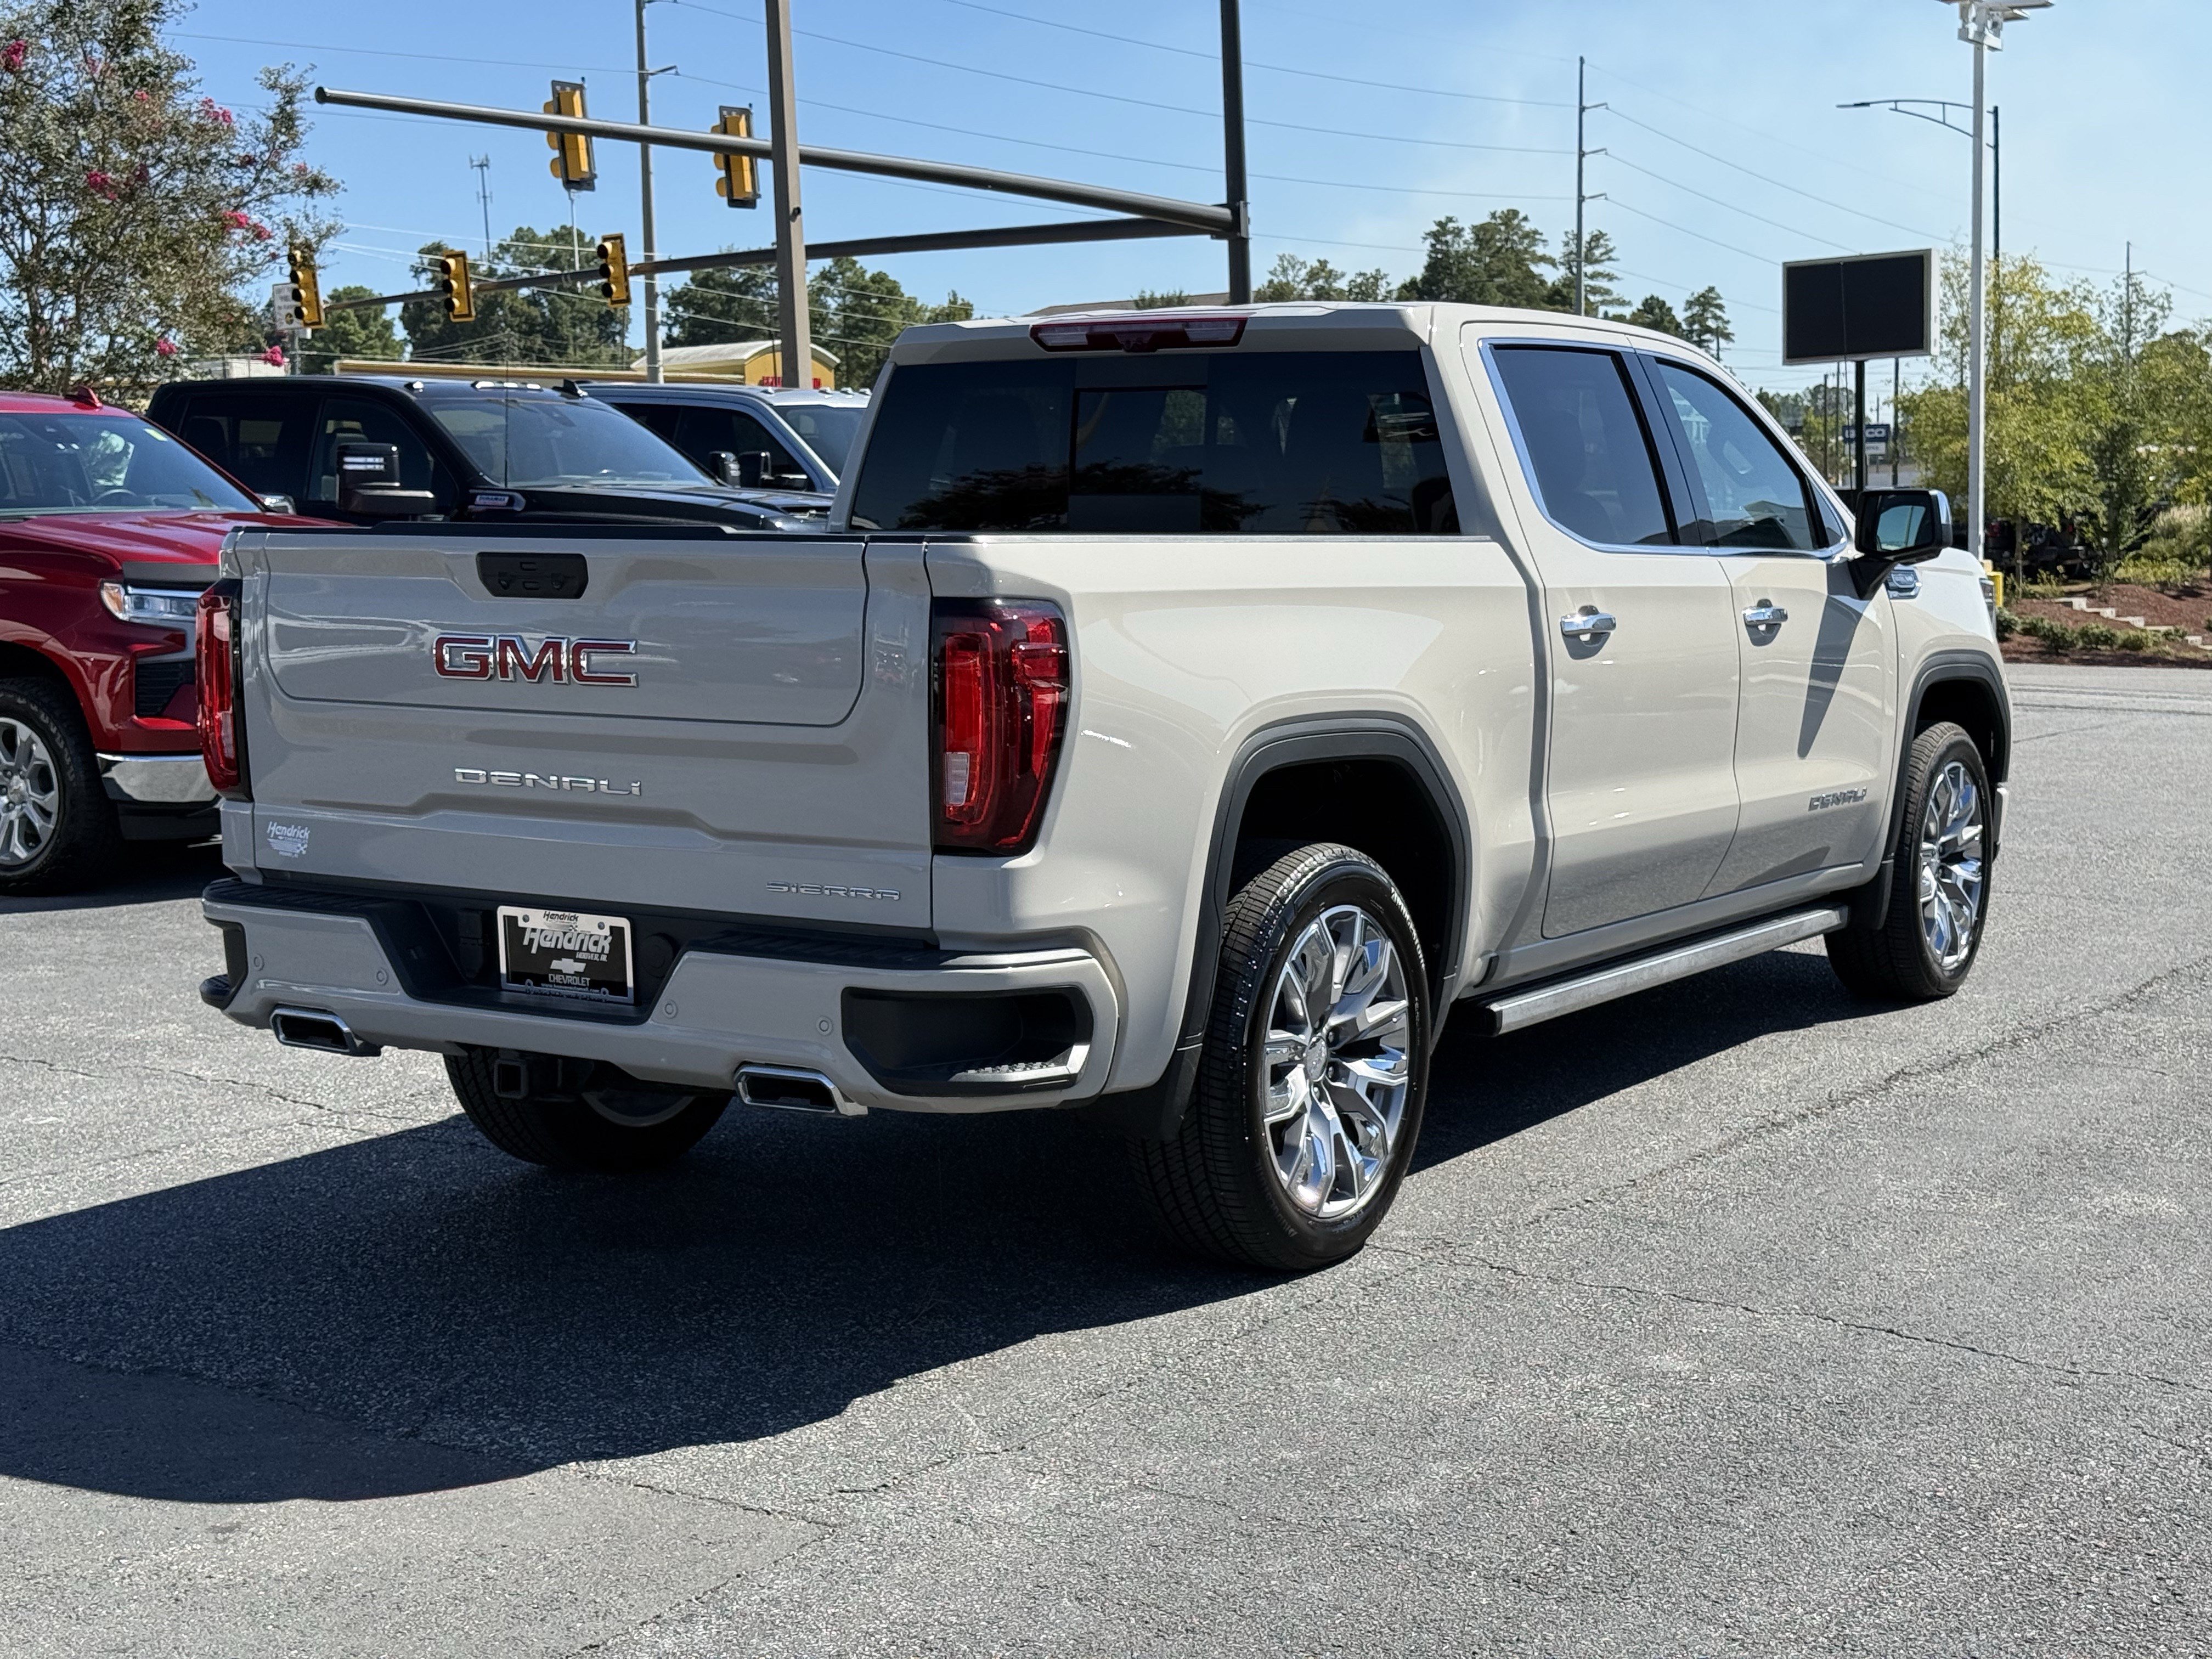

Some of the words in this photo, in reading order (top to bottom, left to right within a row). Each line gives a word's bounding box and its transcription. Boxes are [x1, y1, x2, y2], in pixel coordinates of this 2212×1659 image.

[432, 634, 639, 688] GMC
[455, 768, 642, 797] DENALI
[1808, 786, 1867, 812] DENALI
[267, 821, 311, 839] Hendrick
[766, 881, 901, 900] SIERRA
[542, 911, 579, 922] Hendrick
[522, 927, 612, 954] Hendrick
[549, 973, 591, 986] CHEVROLET
